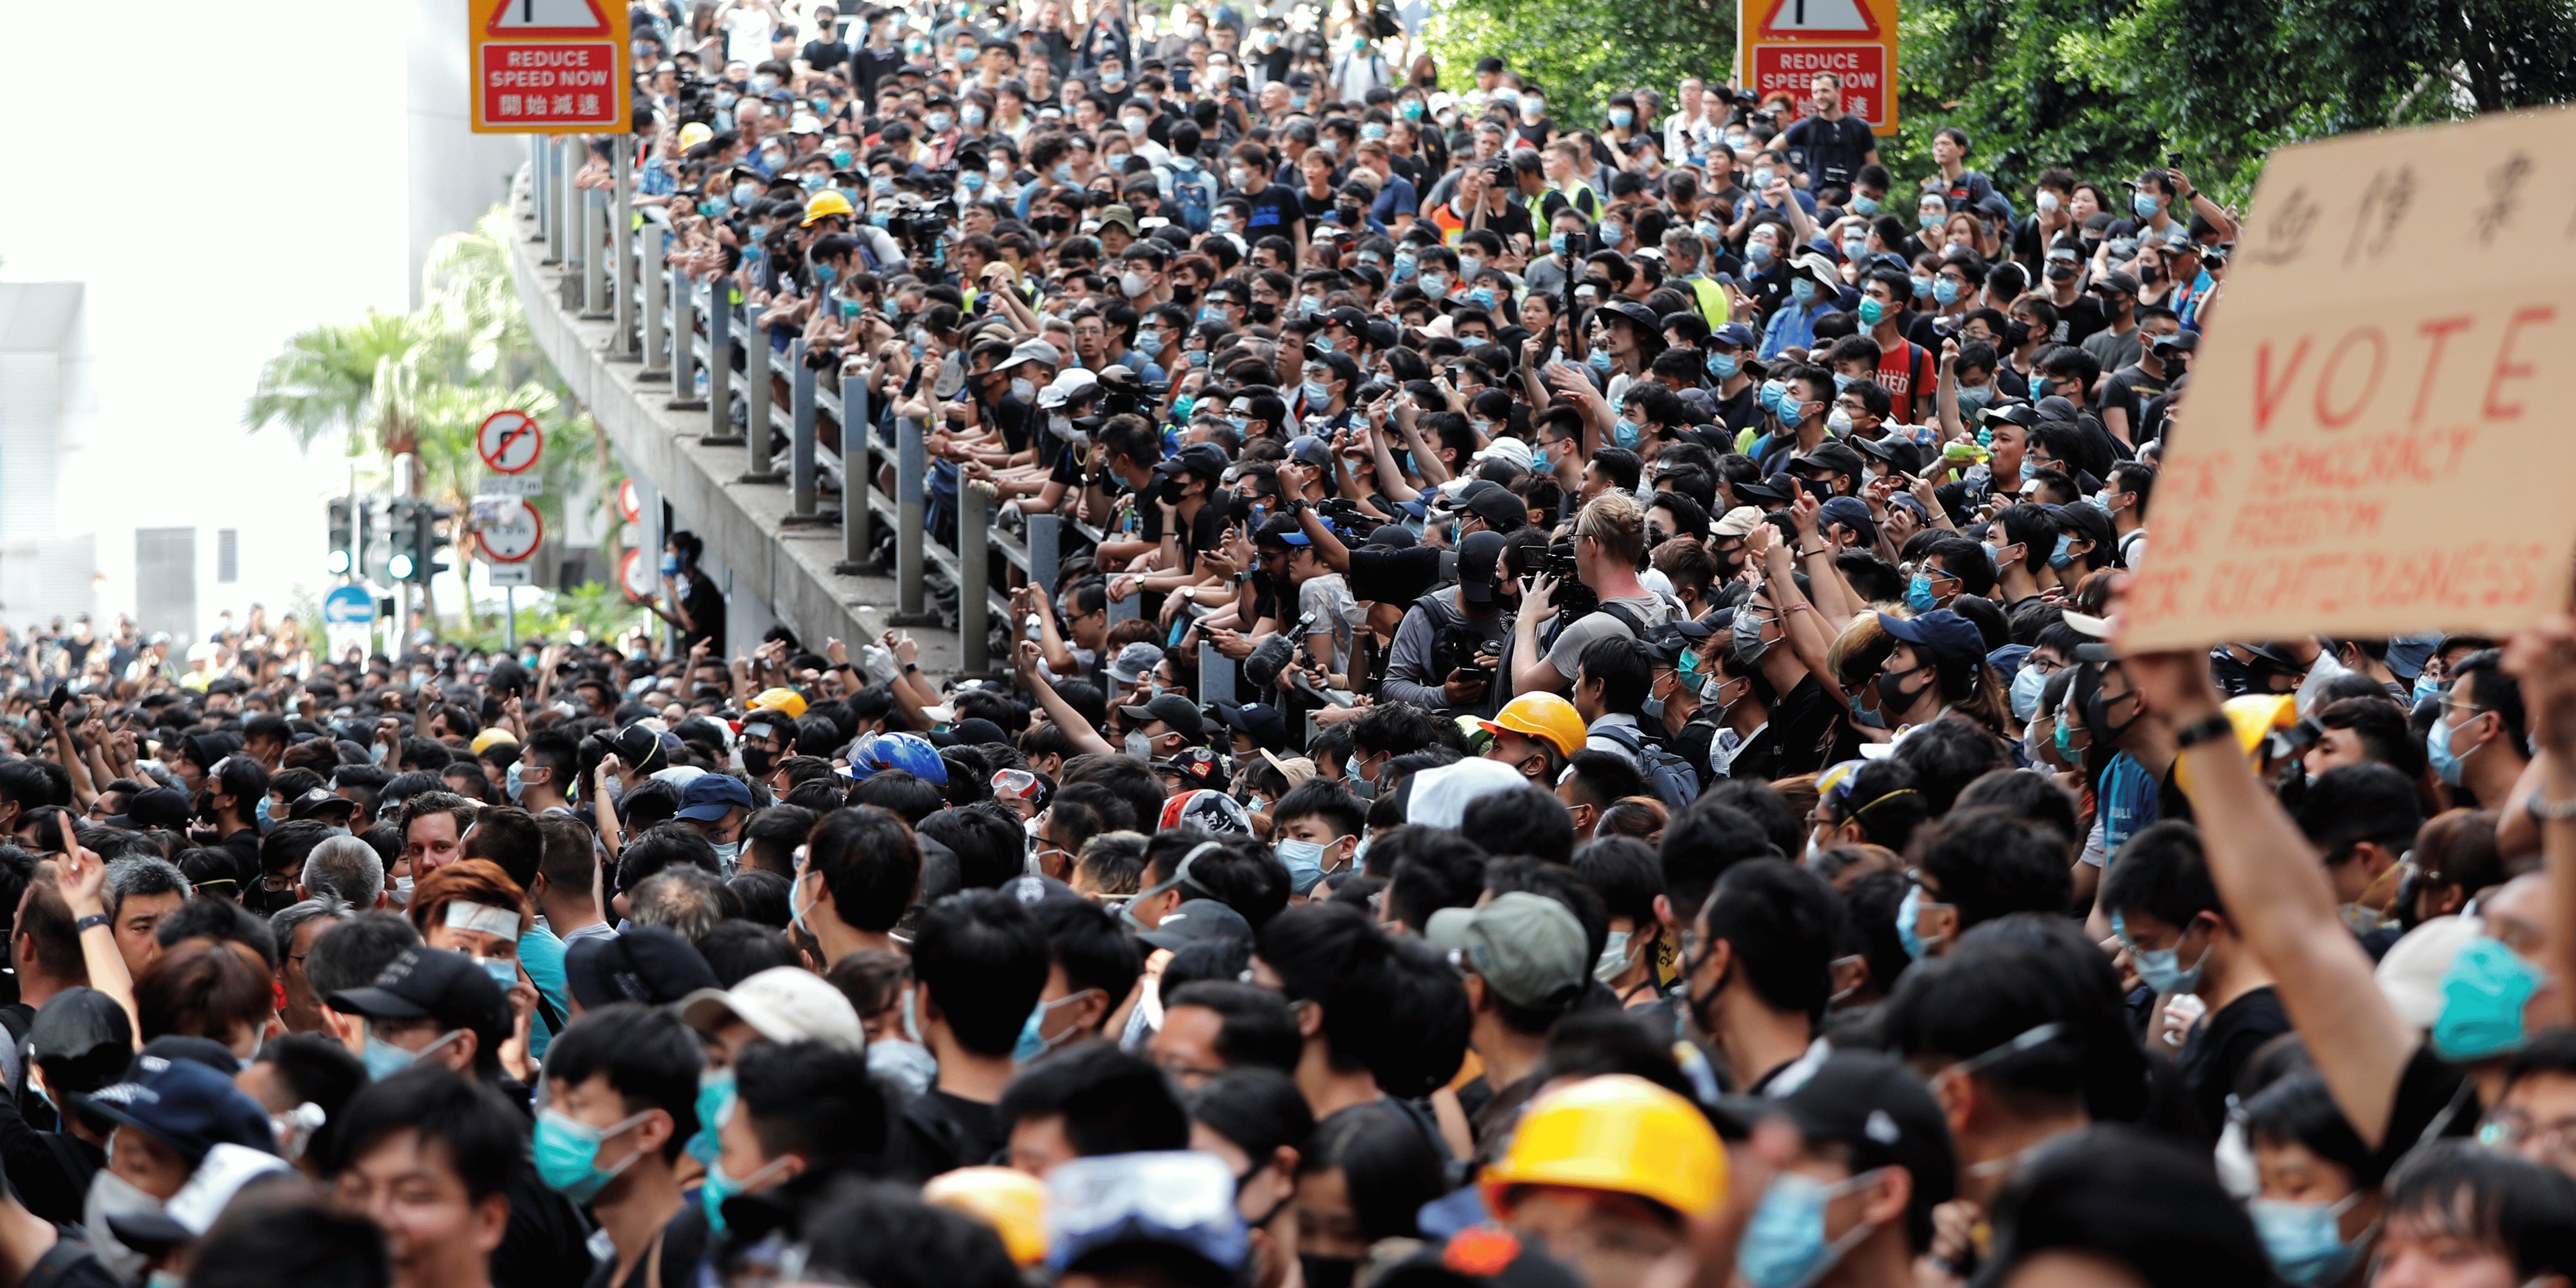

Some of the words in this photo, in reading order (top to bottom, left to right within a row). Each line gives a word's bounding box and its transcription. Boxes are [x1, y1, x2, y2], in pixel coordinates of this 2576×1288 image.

[507, 50, 589, 67] REDUCE
[1780, 53, 1859, 69] REDUCE
[490, 70, 555, 87] SPEED
[559, 70, 608, 86] NOW
[1762, 72, 1813, 89] SPEE
[498, 94, 600, 116] 開始減速
[2252, 302, 2561, 433] VOTE
